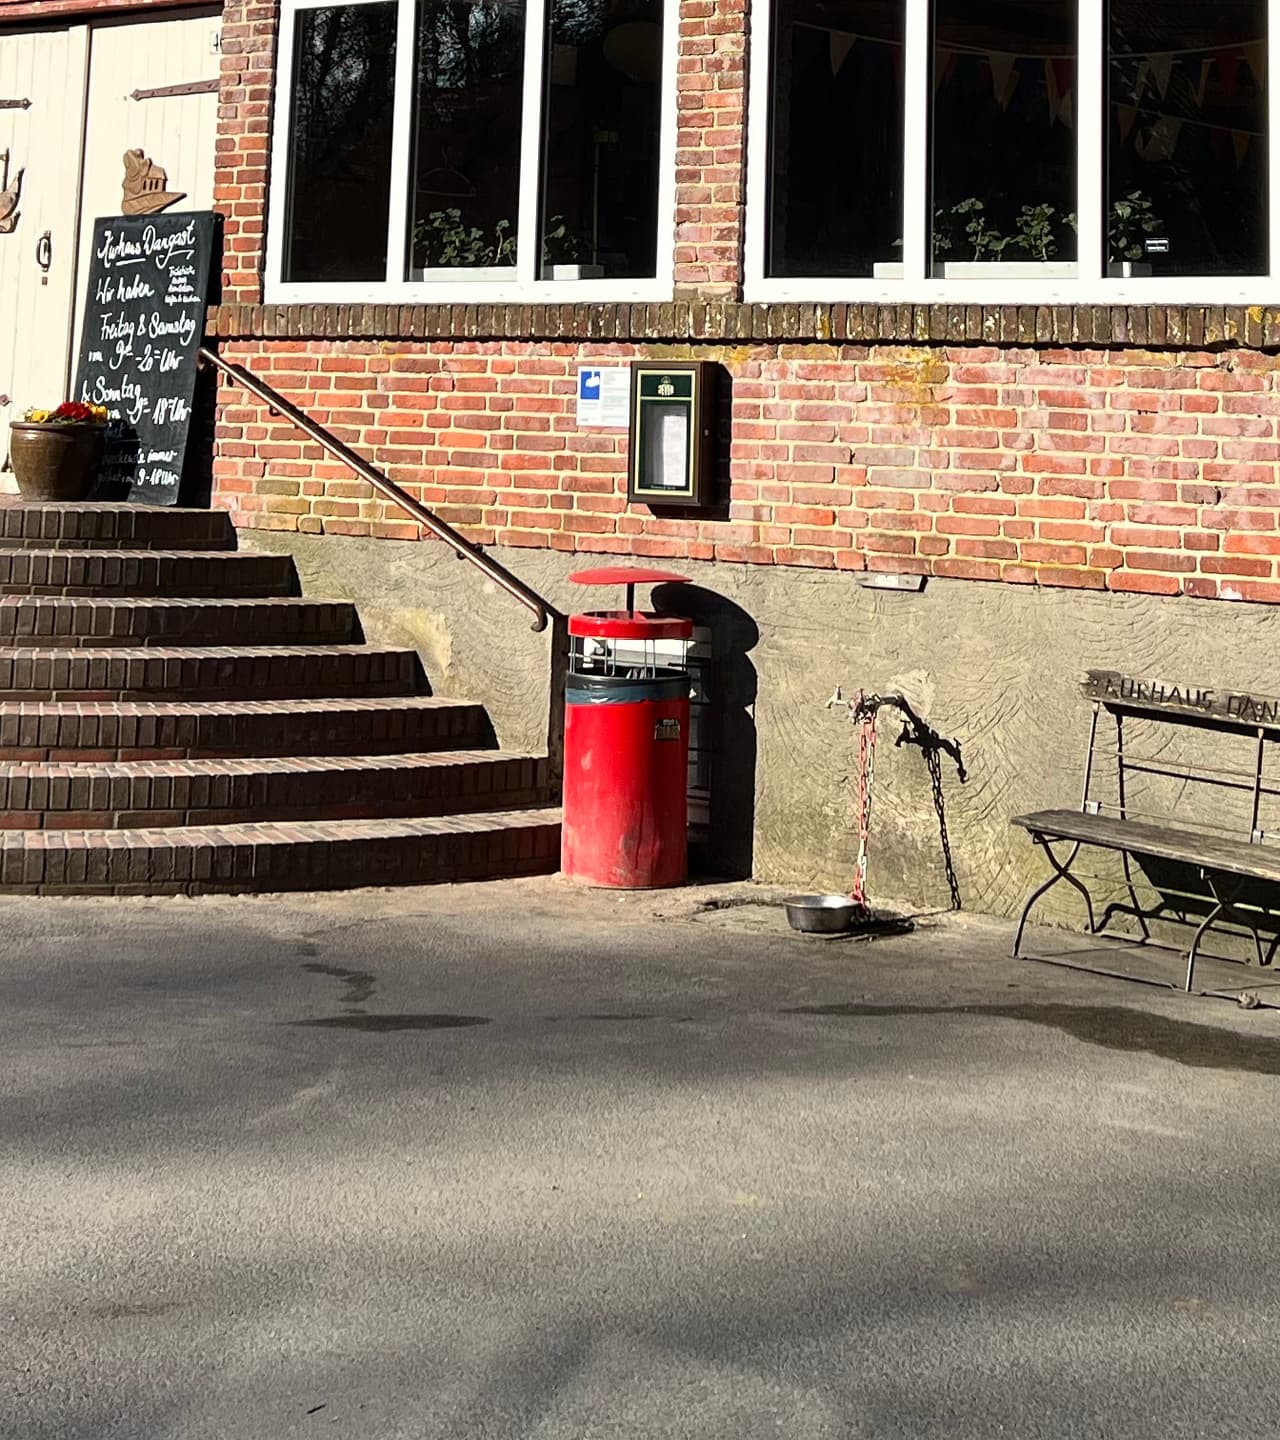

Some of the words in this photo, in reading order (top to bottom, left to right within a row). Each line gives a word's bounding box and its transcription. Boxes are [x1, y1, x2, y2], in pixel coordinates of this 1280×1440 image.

[97, 230, 142, 268] Kurhaus
[143, 219, 195, 269] Dangast
[96, 276, 115, 304] Wir
[117, 274, 155, 302] haben
[101, 311, 135, 345] Freitag
[149, 310, 196, 346] Samstag
[93, 374, 141, 415] Sonntag
[1104, 678, 1214, 709] KURHAUS
